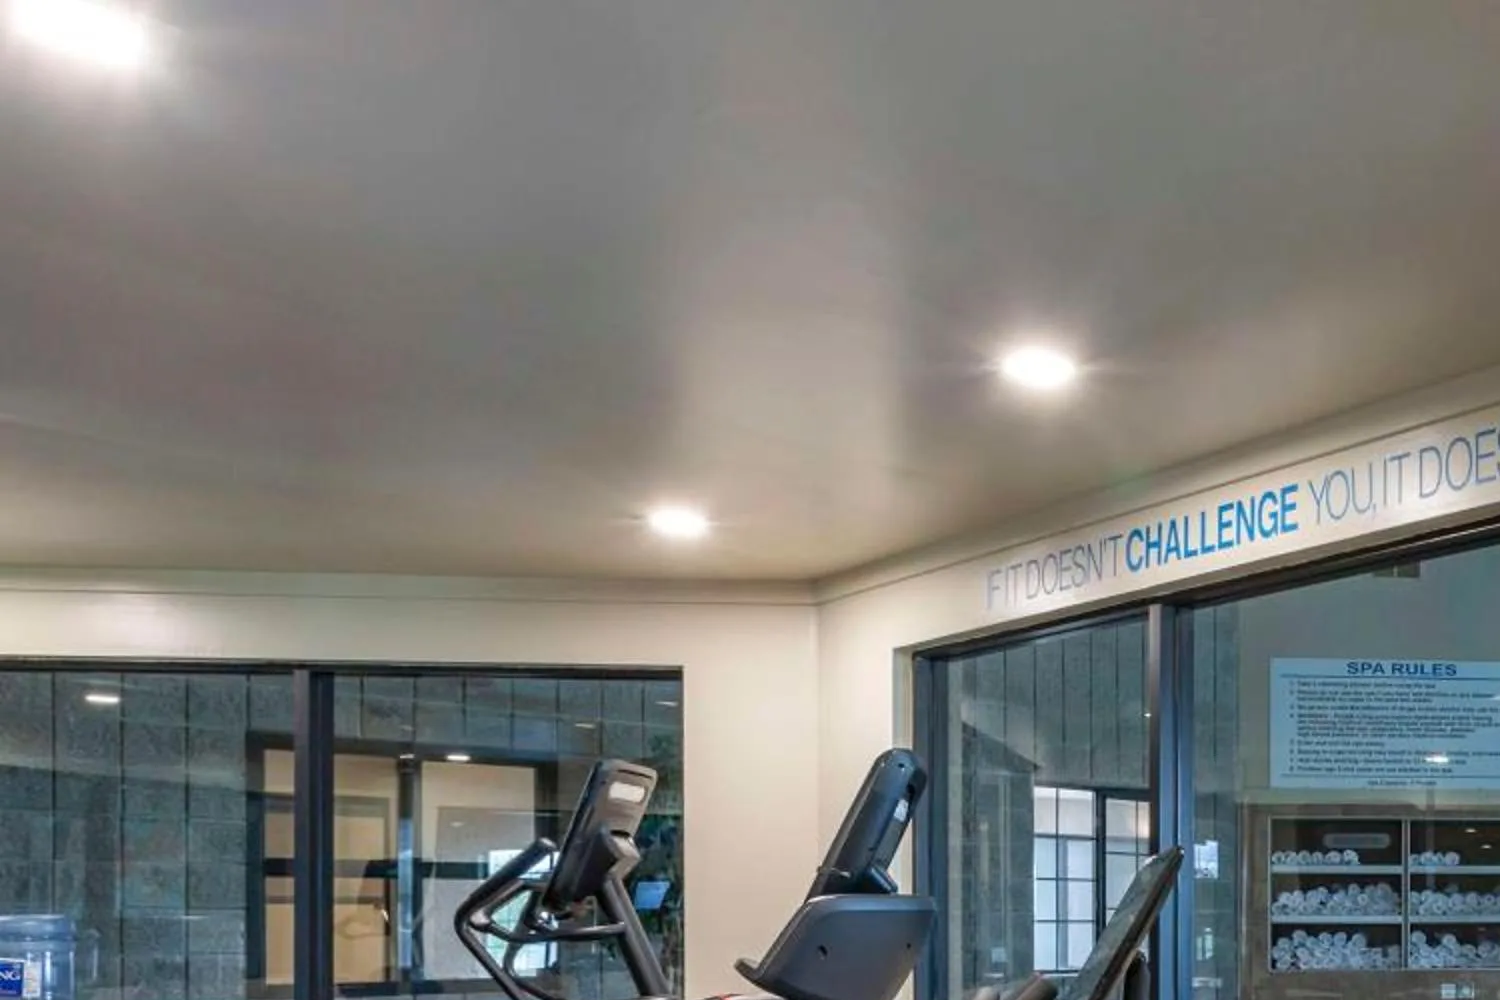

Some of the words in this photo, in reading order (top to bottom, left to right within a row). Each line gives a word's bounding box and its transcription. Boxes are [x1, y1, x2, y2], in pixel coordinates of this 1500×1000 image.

[1026, 533, 1124, 600] DOESN'T
[1125, 483, 1299, 574] CHALLENGE
[1382, 451, 1412, 507] IT
[1346, 661, 1386, 676] SPA
[1391, 662, 1458, 677] RULES
